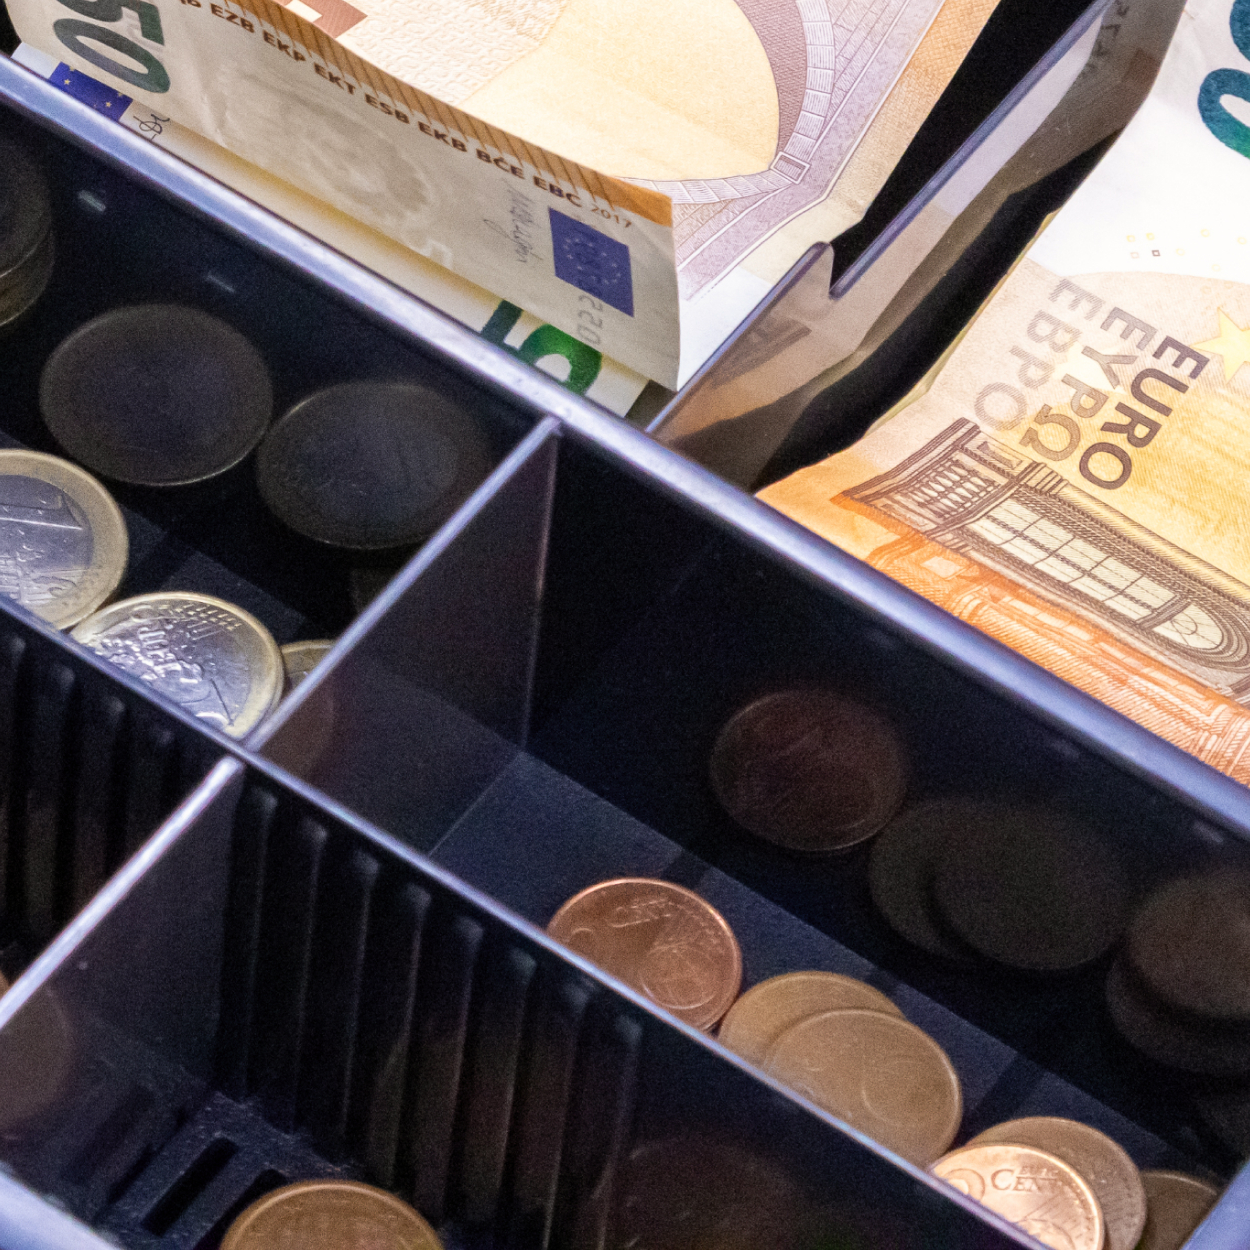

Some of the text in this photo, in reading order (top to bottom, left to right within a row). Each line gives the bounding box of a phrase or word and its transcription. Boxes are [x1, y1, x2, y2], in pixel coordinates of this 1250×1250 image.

[210, 2, 256, 34] EZB
[313, 62, 357, 96] EKT
[365, 92, 411, 125] ESB
[418, 120, 468, 153] EKB
[533, 175, 582, 208] EBC
[590, 205, 632, 229] 2017
[1078, 335, 1210, 490] EURO
